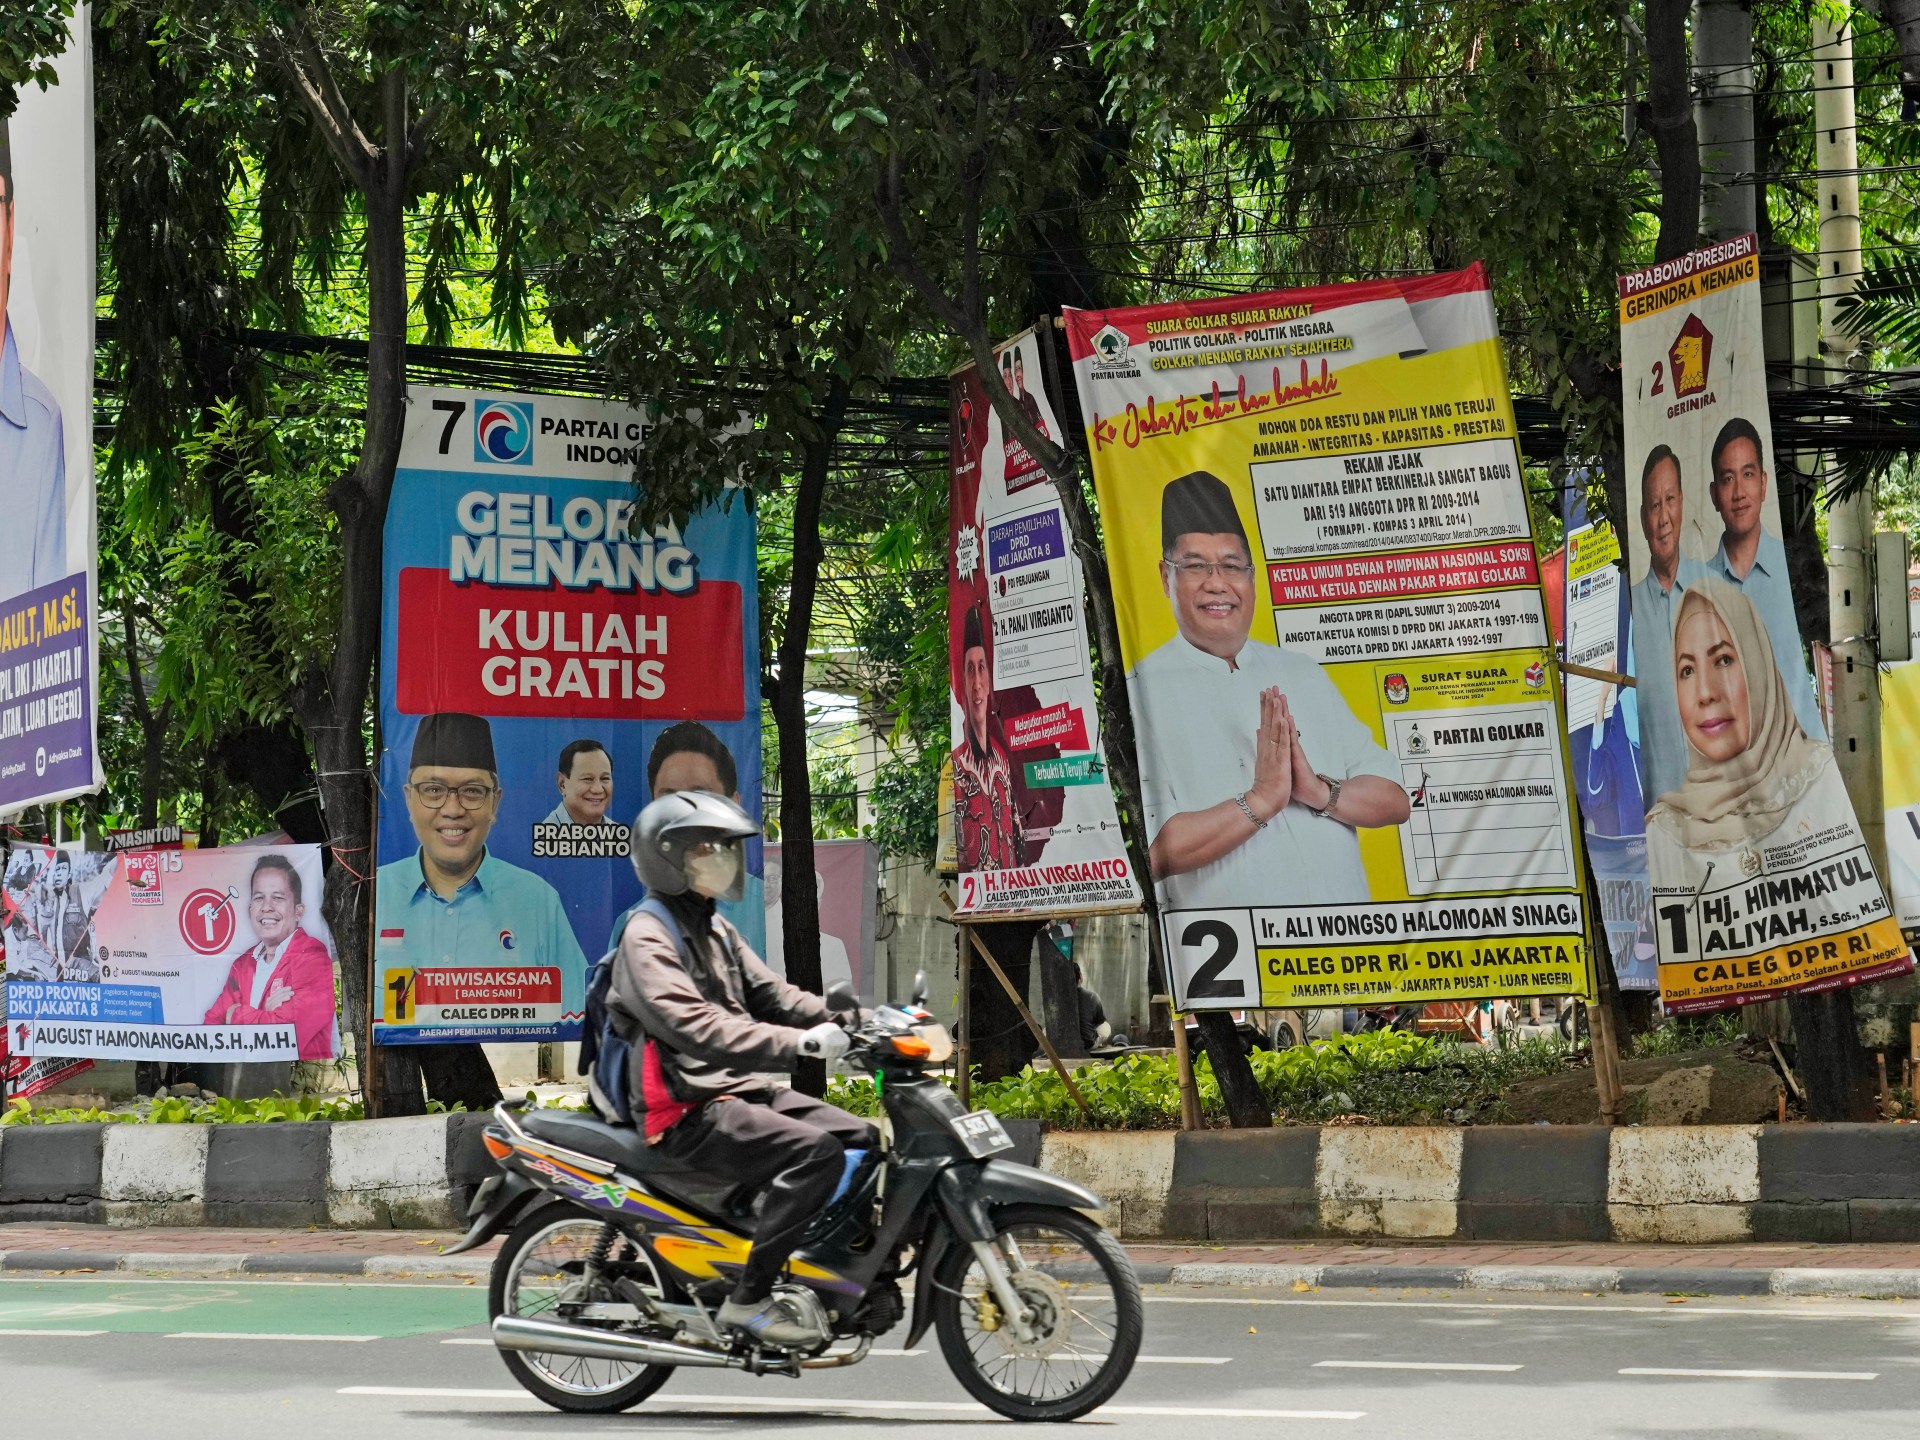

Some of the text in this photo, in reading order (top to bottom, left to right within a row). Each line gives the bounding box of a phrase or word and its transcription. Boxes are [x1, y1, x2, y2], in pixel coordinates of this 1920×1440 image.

[1626, 236, 1751, 293] PRABOWO PRESIDEN
[1626, 260, 1754, 318] GERINDRA MENANG
[1146, 304, 1312, 334] SUARA GOLKAR SUARA RAKYAT
[1152, 338, 1353, 370] GOLKAR MENANG RAKYAT SEJAHTERA
[1091, 370, 1141, 380] PARTAI GOLKAR
[1650, 361, 1664, 397] 2
[432, 400, 466, 455] 7
[540, 417, 619, 440] PARTAI
[1258, 398, 1496, 436] MOHON DOA RESTU DAN PILIH YANG TERUJI
[1343, 452, 1424, 474] REKAM JEJAK
[1303, 490, 1480, 521] DARI 519 ANGGOTA DPR RI 2009-2014
[991, 514, 1054, 543] DAERAH PEMILIHAN
[1010, 535, 1029, 550] DPRD
[449, 534, 699, 593] MENANG
[998, 543, 1051, 567] DKI JAKARTA 8
[1273, 547, 1531, 582] KETUA UMUM DEWAN PIMPINAN NASIONAL SOKSI
[993, 581, 998, 593] 3
[1016, 569, 1050, 587] PERJUANGAN
[1570, 583, 1578, 602] 14
[0, 587, 82, 653] AULT, M.Si.
[479, 608, 668, 655] KULIAH
[994, 604, 1073, 636] 2 H. PANJI VIRGIANTO
[15, 663, 29, 697] DKI
[32, 649, 72, 692] JAKARTA
[74, 646, 82, 680] II
[481, 655, 666, 699] GRATIS
[1421, 667, 1507, 683] SURAT SUARA
[0, 687, 82, 739] ATAN, LUAR NEGERI)
[1433, 722, 1544, 746] PARTAI GOLKAR
[69, 746, 82, 759] Dault
[1034, 761, 1083, 780] Terbukti & Teruji
[104, 825, 180, 852] 7 MASINTON
[532, 823, 631, 842] PRABOWO
[1819, 829, 1854, 845] KEMAJUAN
[125, 851, 183, 872] PSI 15
[531, 839, 631, 858] SUBIANTO
[962, 877, 976, 909] 2
[984, 873, 998, 892] H.
[1001, 867, 1041, 890] PANJI
[1041, 858, 1128, 885] VIRGIANTO
[986, 879, 1131, 903] CALEG DPRD PROV. DKI JAKARTA DAPIL 8
[1652, 885, 1695, 894] Nomor Urut
[1703, 856, 1873, 927] Hj. HIMMATUL
[197, 902, 214, 941] 1
[1260, 907, 1506, 939] Ir. ALI WONGSO HALOMOAN
[1659, 903, 1688, 954] 1
[1705, 908, 1817, 953] ALIYAH,
[1859, 897, 1886, 917] M.Si
[112, 951, 148, 959] AUGUSTHAM
[1180, 919, 1246, 999] 2
[1267, 945, 1566, 976] CALEG DPR RI DKI JAKARTA
[1693, 932, 1872, 982] CALEG DPR RI
[63, 967, 88, 982] DPRD
[1665, 946, 1901, 999] Dapil Jakarta Pusat, Jakarta Selatan & Luar Negeri
[9, 985, 101, 1002] DPRD PROVINSI
[388, 971, 552, 1020] 1 TRIWISAKSANA
[461, 988, 516, 999] BANG SANI
[9, 1001, 98, 1017] DKI JAKARTA 8
[441, 1006, 536, 1019] CALEG DPR RI
[15, 1022, 25, 1051] 1
[35, 1027, 92, 1046] AUGUST
[419, 1026, 558, 1037] DAERAH PEMILIHAN DKI JAKARTA 2
